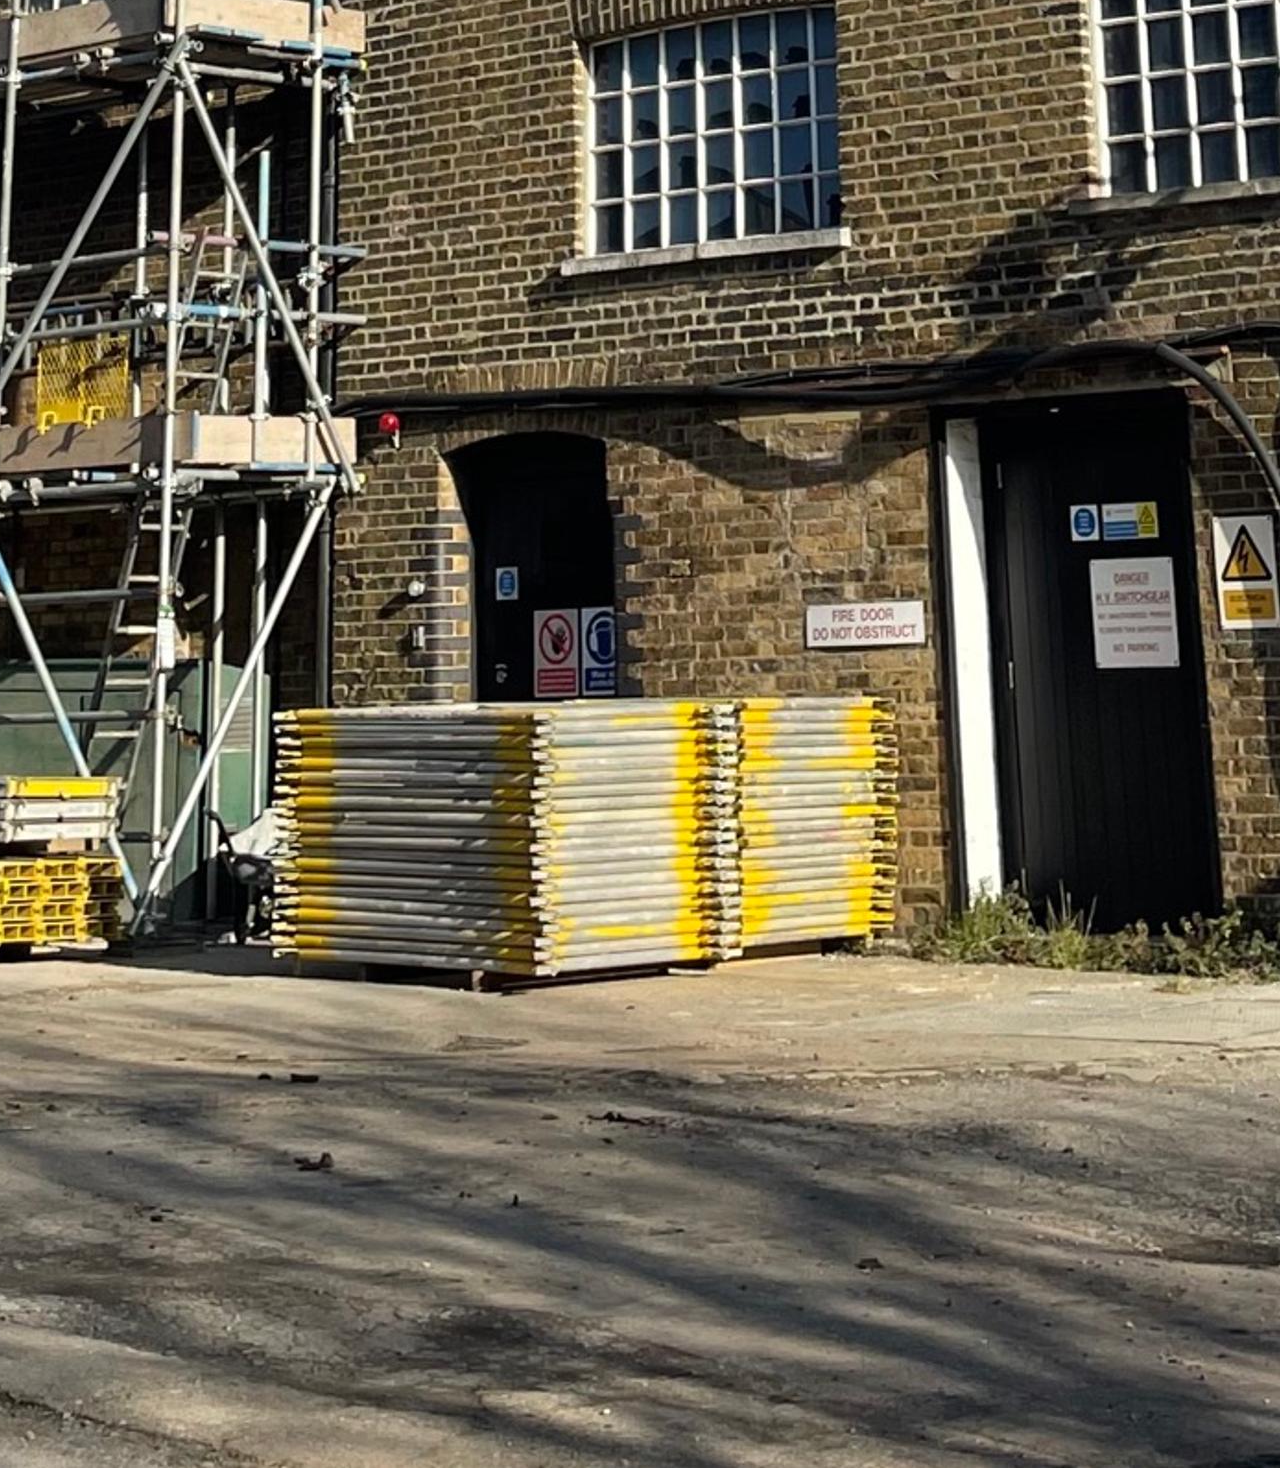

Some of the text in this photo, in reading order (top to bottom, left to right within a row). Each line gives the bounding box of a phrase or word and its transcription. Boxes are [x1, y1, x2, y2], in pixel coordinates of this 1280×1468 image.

[832, 608, 894, 622] FIRE DOOR
[813, 624, 916, 641] DO NOT OBSTRUCT
